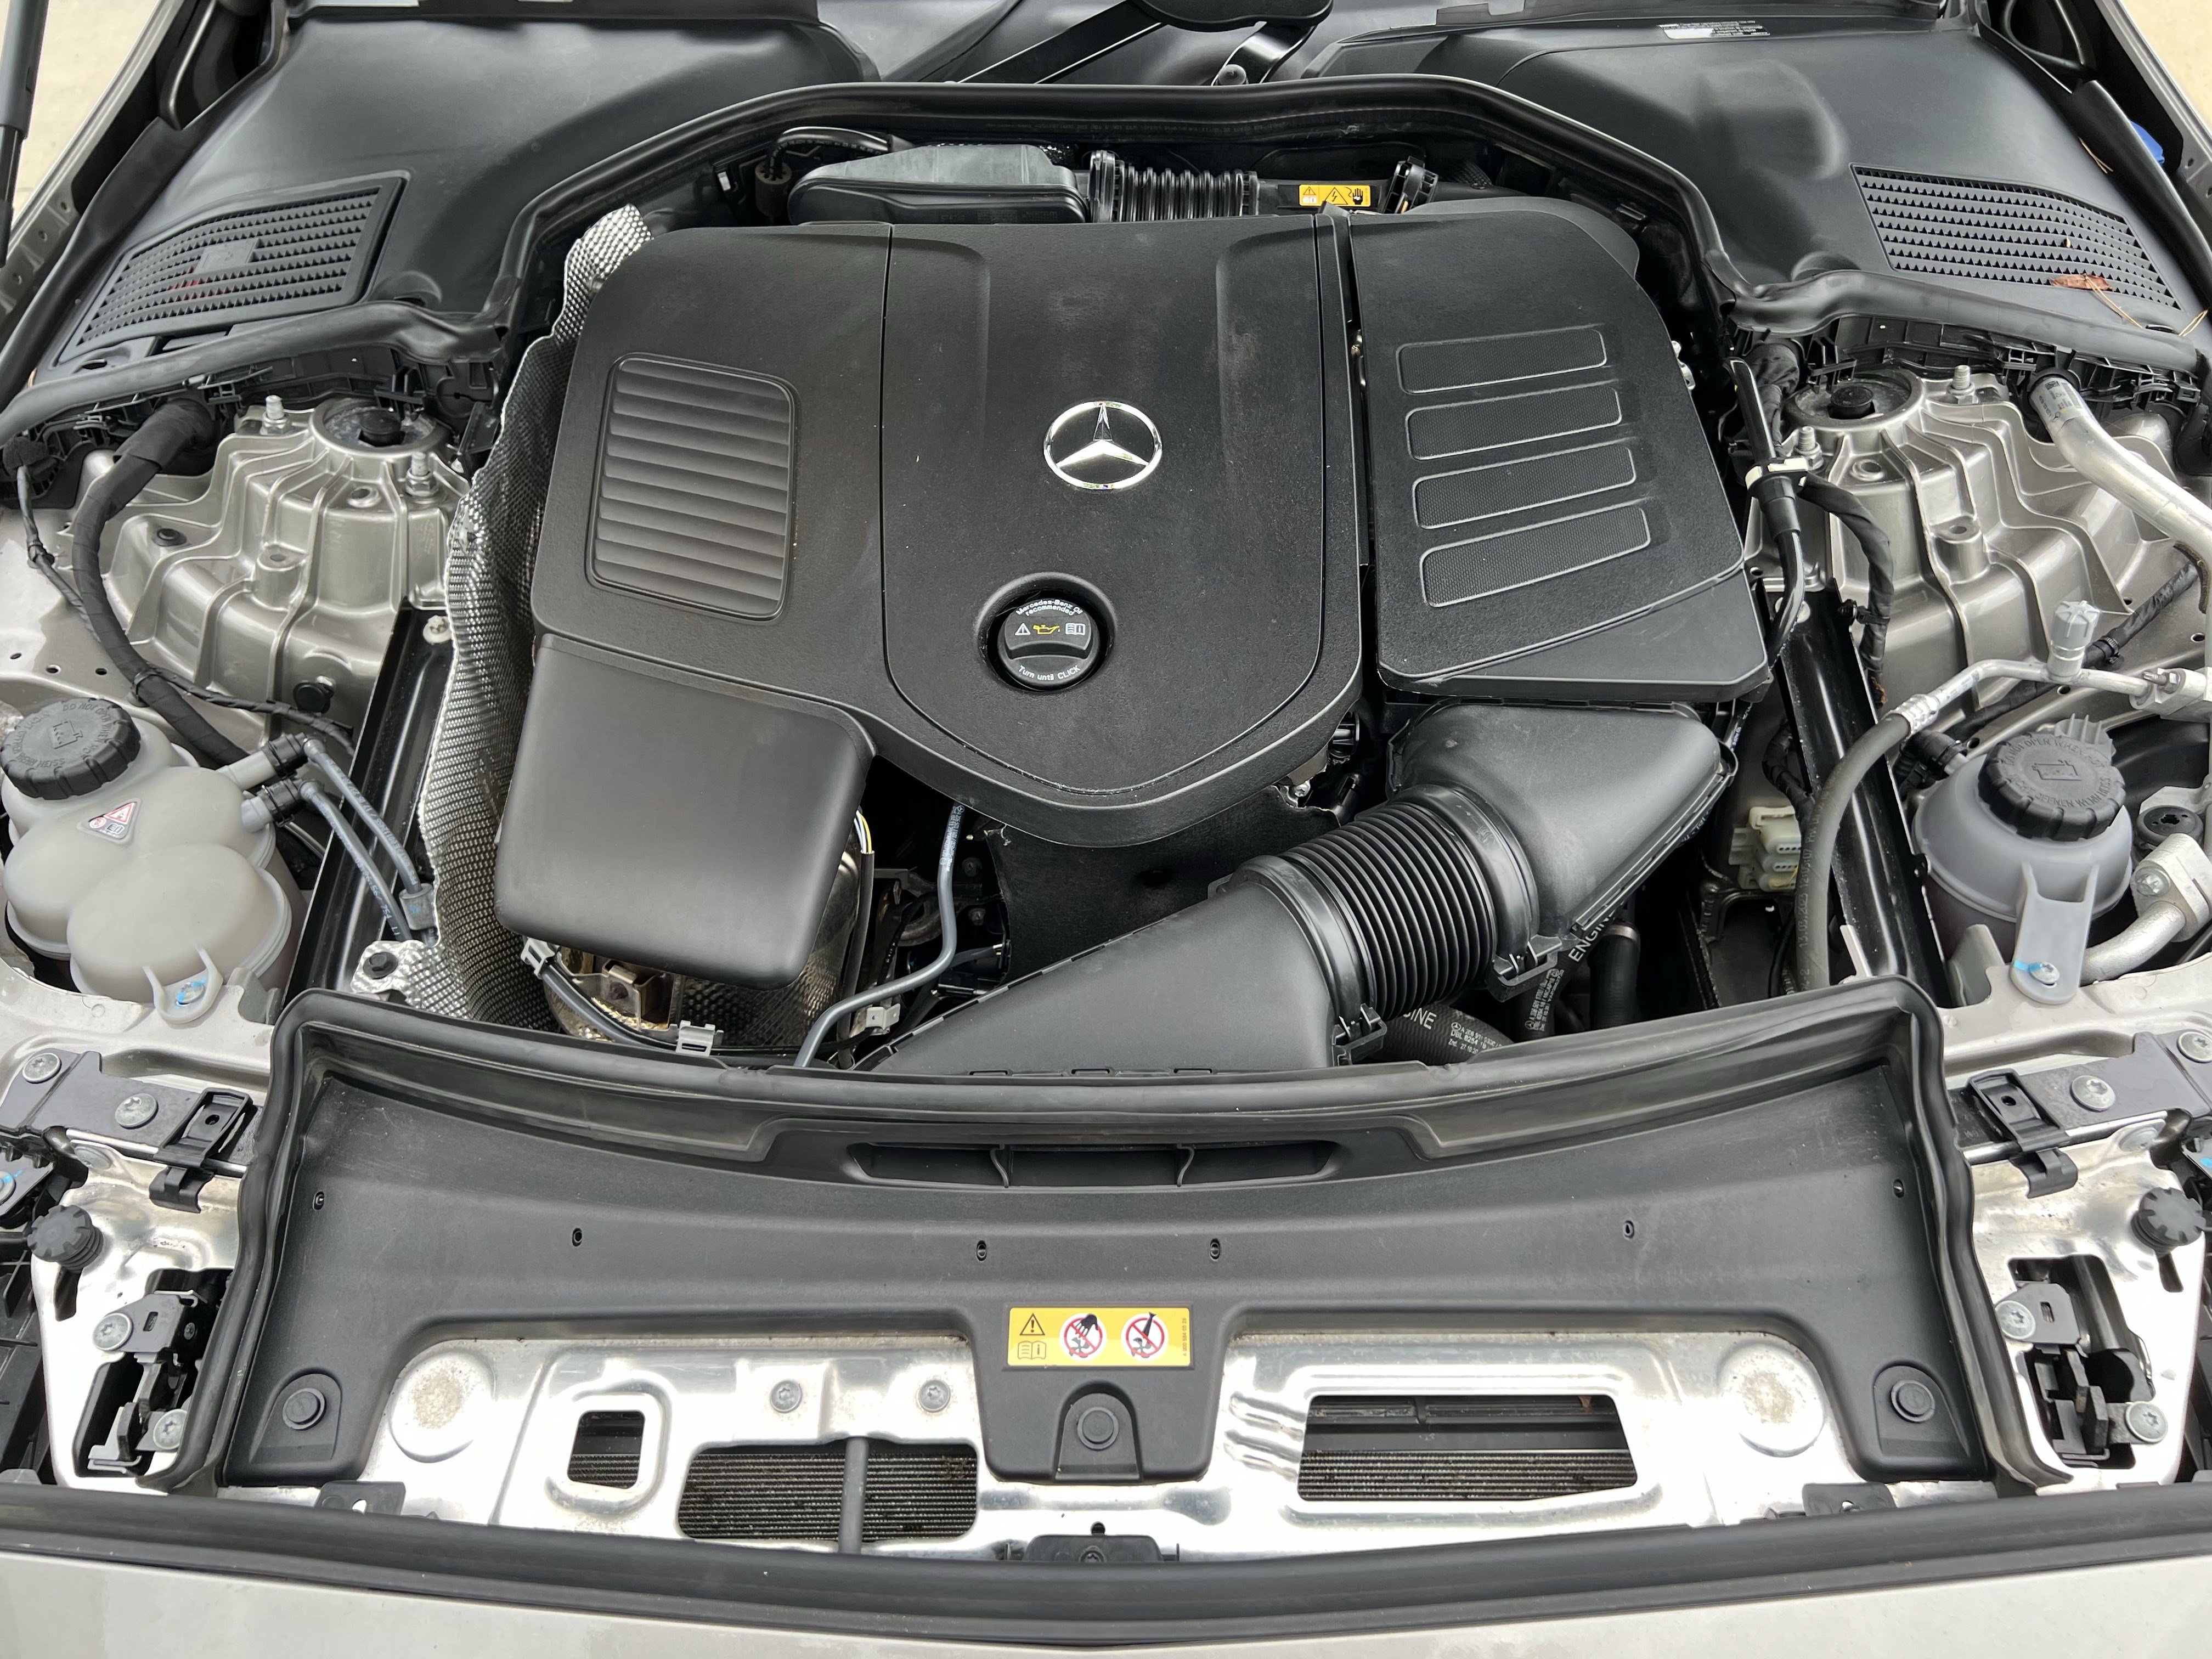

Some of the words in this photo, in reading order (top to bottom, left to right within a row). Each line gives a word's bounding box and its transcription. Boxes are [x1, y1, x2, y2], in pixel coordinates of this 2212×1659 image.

[1016, 600, 1073, 614] Mercedes-Benz
[1025, 605, 1075, 616] recommended
[1019, 665, 1035, 678] Turn
[1057, 665, 1080, 679] CLICK
[36, 758, 65, 768] HEISS
[1798, 893, 1808, 948] 13.03.2023
